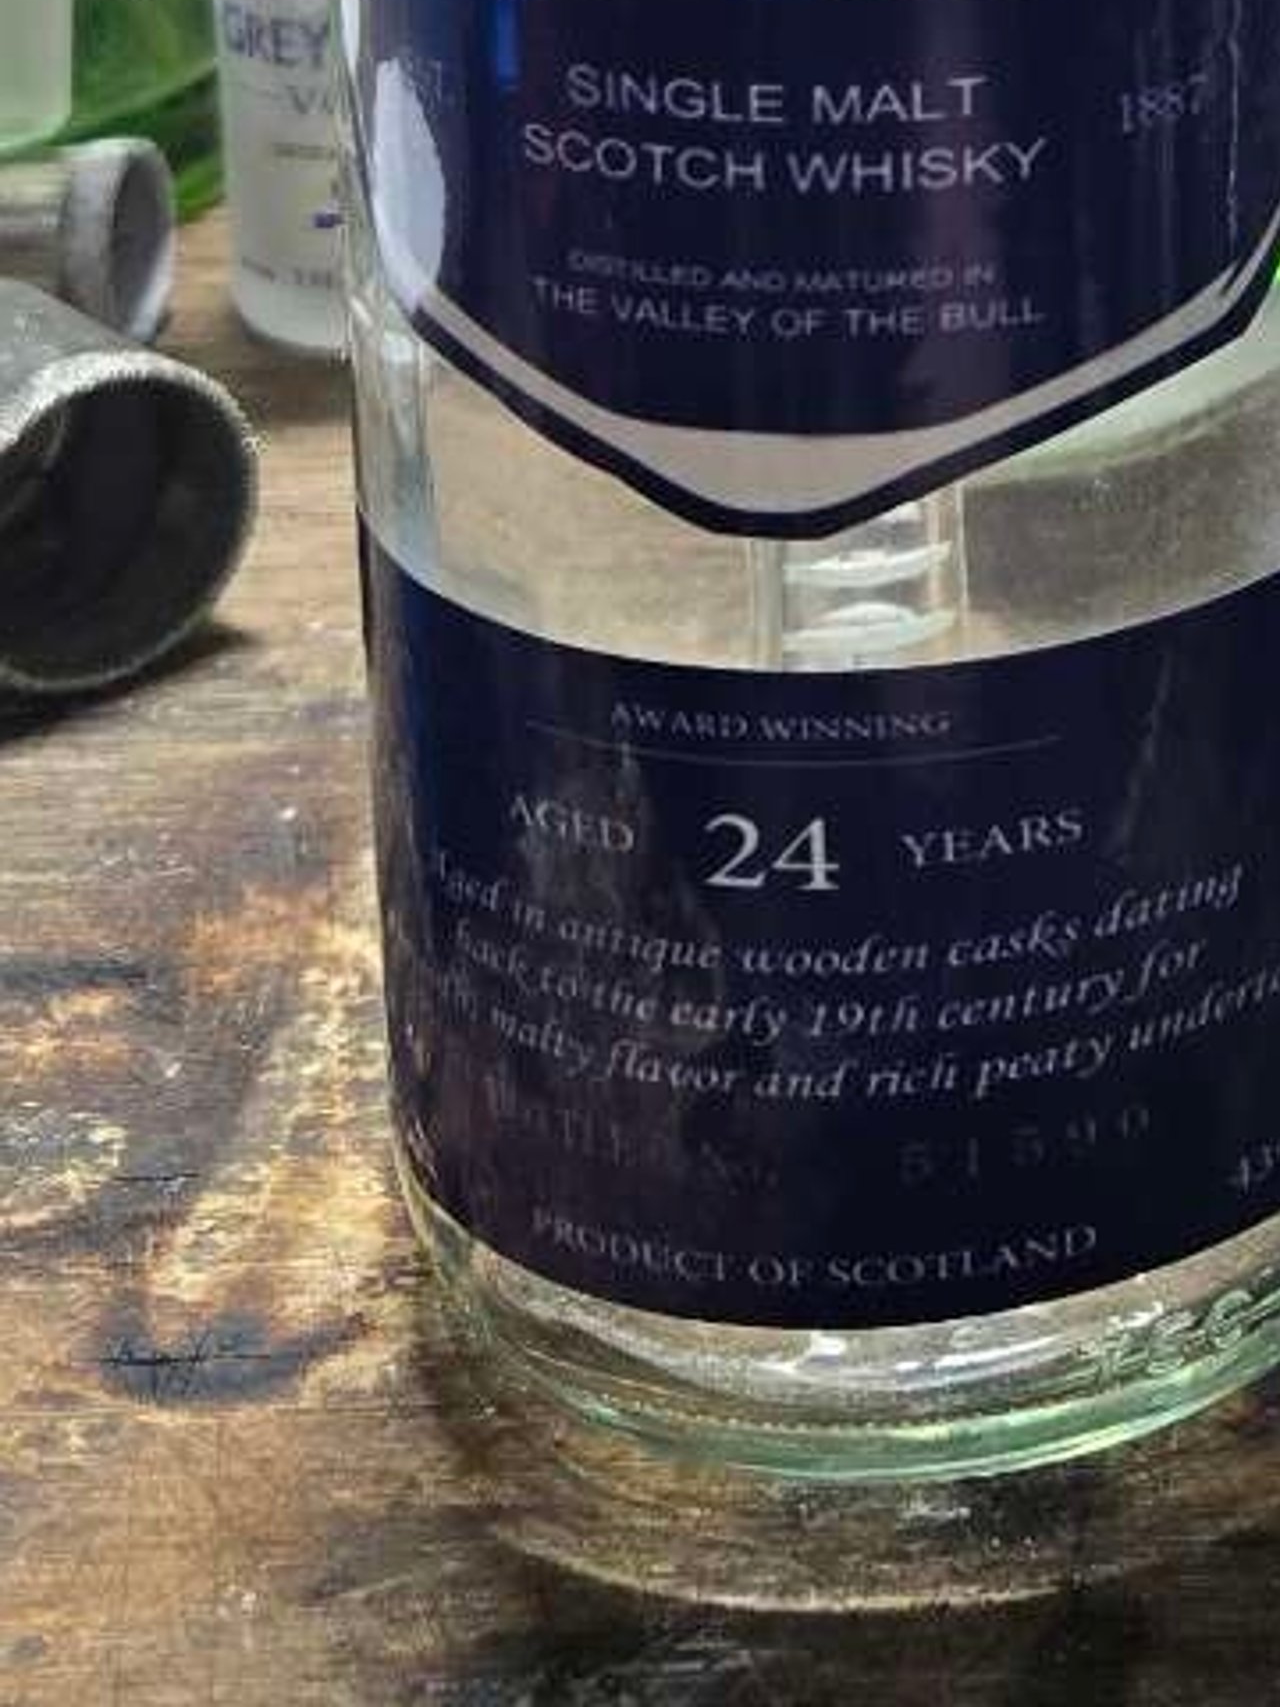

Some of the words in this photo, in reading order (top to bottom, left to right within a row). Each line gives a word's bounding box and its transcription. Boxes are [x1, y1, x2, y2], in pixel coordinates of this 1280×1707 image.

[564, 63, 784, 124] SINGLE
[810, 76, 990, 126] MALT
[523, 122, 765, 192] SCOTCH
[787, 136, 1050, 194] WHISKY
[531, 277, 597, 316] THE
[610, 294, 759, 336] VALLEY
[770, 306, 832, 337] OF
[843, 306, 925, 337] THE
[938, 295, 1046, 332] BULL
[720, 267, 789, 293] AND
[508, 795, 636, 853] AGED
[703, 812, 841, 892] 24
[900, 808, 1085, 868] YEARS
[559, 916, 723, 973] antique
[742, 934, 930, 975] wooden
[948, 912, 1080, 969] casks
[1094, 865, 1244, 937] dating
[670, 995, 788, 1047] early
[809, 995, 919, 1037] 19th
[938, 970, 1127, 1031] century
[1124, 937, 1208, 1003] for
[604, 1037, 738, 1095] flavor
[753, 1061, 855, 1099] and
[866, 1056, 958, 1098] rich
[976, 1033, 1114, 1099] peaty
[532, 1205, 728, 1282] PRODUCT
[747, 1254, 804, 1287] OF
[825, 1223, 1100, 1286] SCOTLAND
